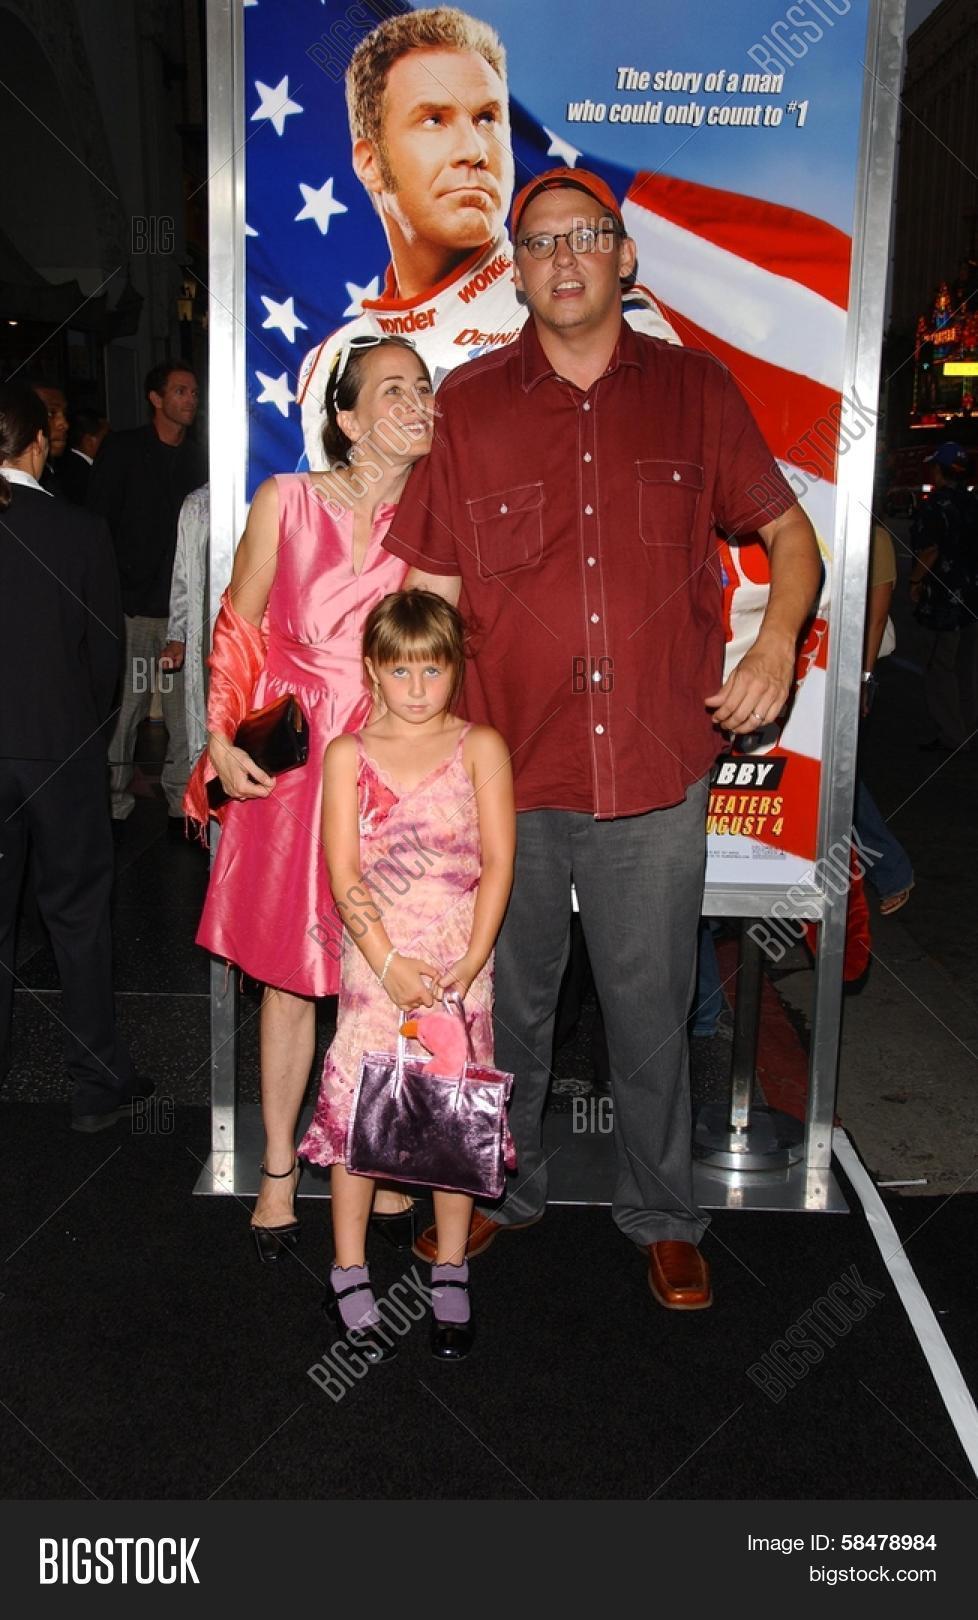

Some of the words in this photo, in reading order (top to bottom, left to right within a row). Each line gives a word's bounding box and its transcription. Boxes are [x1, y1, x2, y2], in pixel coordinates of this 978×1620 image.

[616, 67, 650, 91] The
[653, 70, 702, 93] story
[704, 70, 726, 92] of
[726, 73, 739, 93] a
[741, 73, 784, 93] man
[567, 100, 605, 122] who
[608, 102, 663, 124] could
[664, 102, 704, 126] only
[707, 105, 761, 126] count
[762, 106, 783, 126] to
[786, 100, 809, 126] #1
[712, 762, 774, 786] BBY
[771, 817, 785, 836] 4
